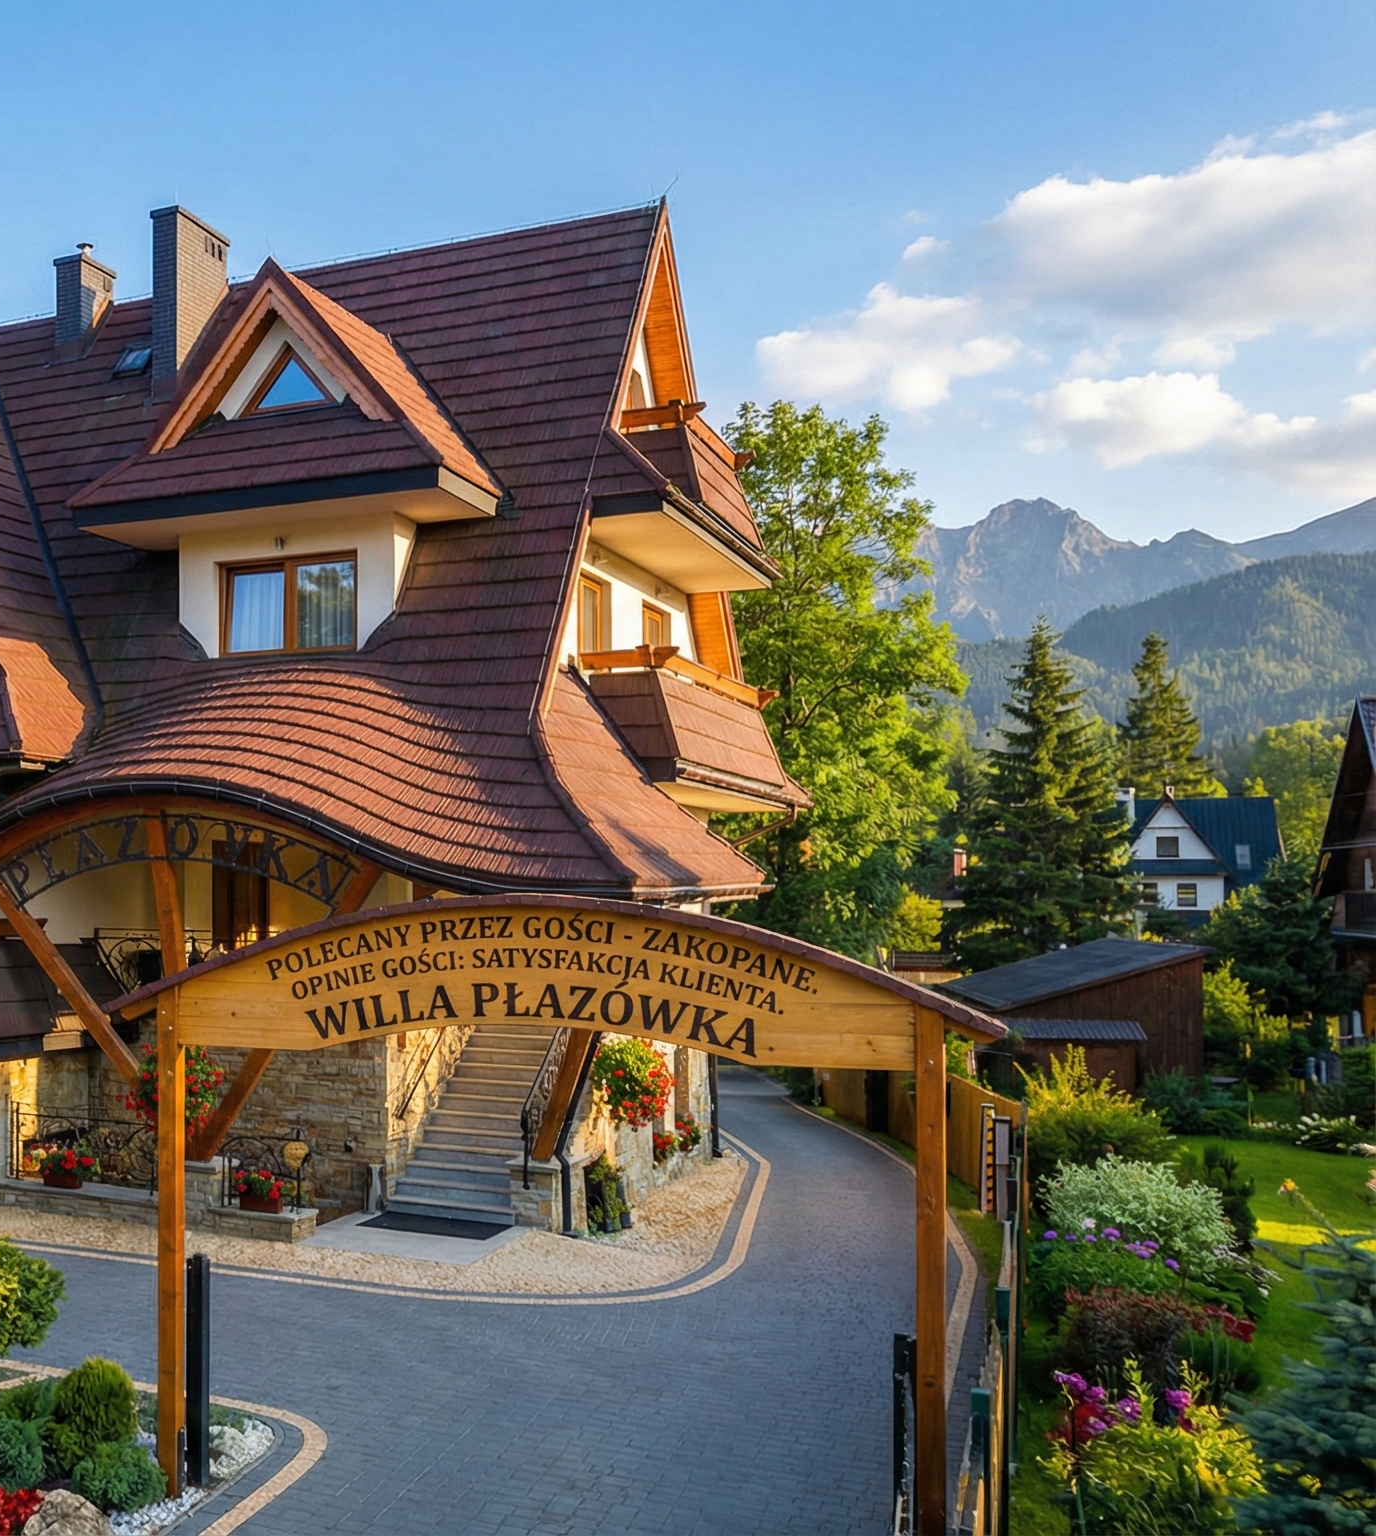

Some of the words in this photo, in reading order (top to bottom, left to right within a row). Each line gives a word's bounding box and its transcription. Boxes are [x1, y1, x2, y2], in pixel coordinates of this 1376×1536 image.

[266, 924, 411, 981] POLECANY
[419, 916, 513, 944] PRZEZ
[522, 912, 616, 945] GOŚCI
[291, 962, 376, 1000] OPINIE
[381, 948, 465, 979] GOŚCI:
[471, 948, 651, 982] SATYSFAKCJA
[658, 962, 785, 1015] KLIENTA.
[304, 984, 459, 1040] WILLA
